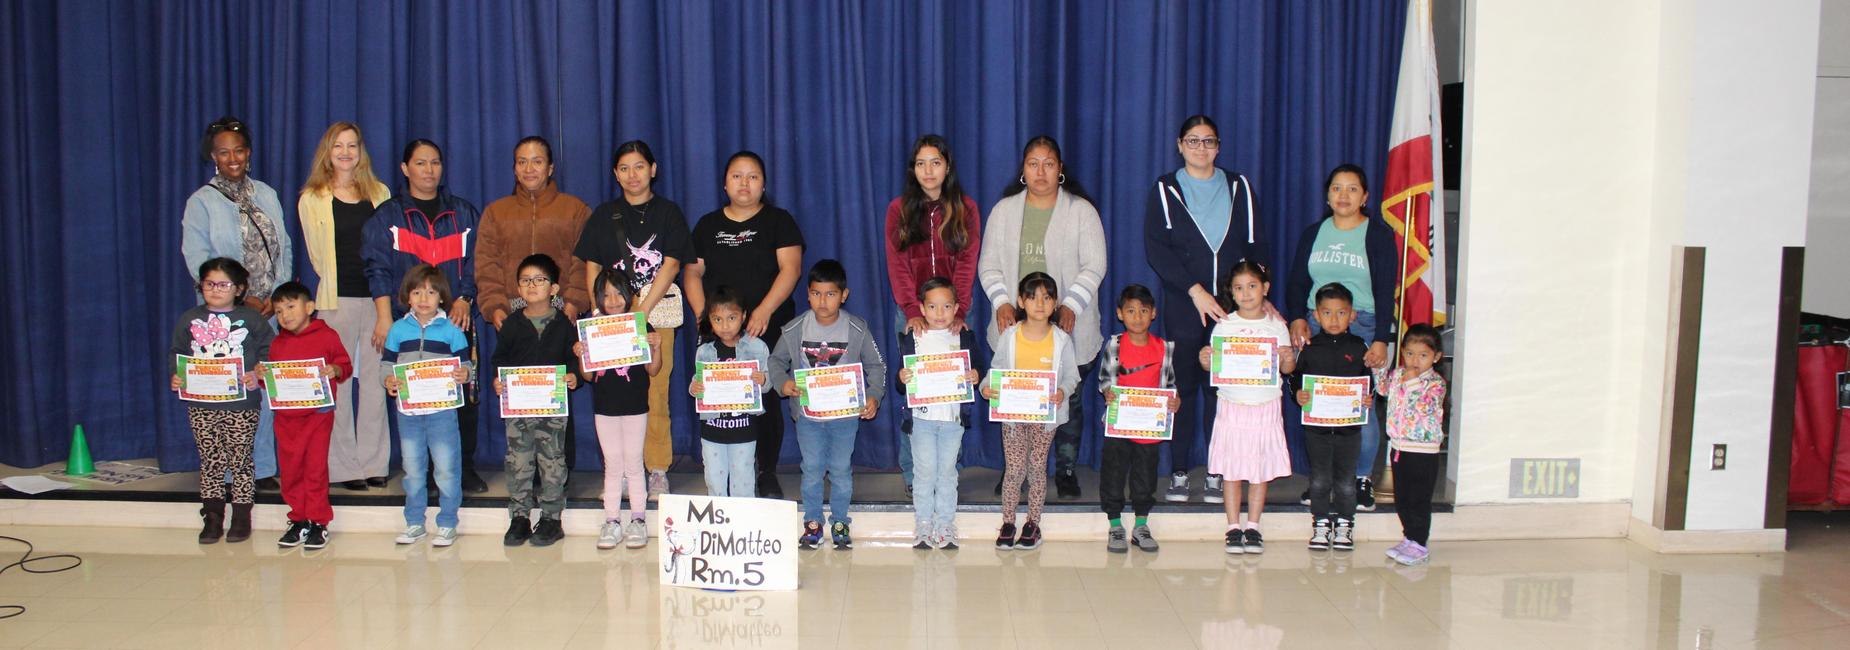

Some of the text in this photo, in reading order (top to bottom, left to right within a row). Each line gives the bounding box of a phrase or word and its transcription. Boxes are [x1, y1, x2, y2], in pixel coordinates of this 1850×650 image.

[706, 414, 750, 429] Kuromi
[1522, 461, 1569, 496] EXIT
[687, 500, 730, 525] Ms.
[700, 530, 782, 556] DiMatteo
